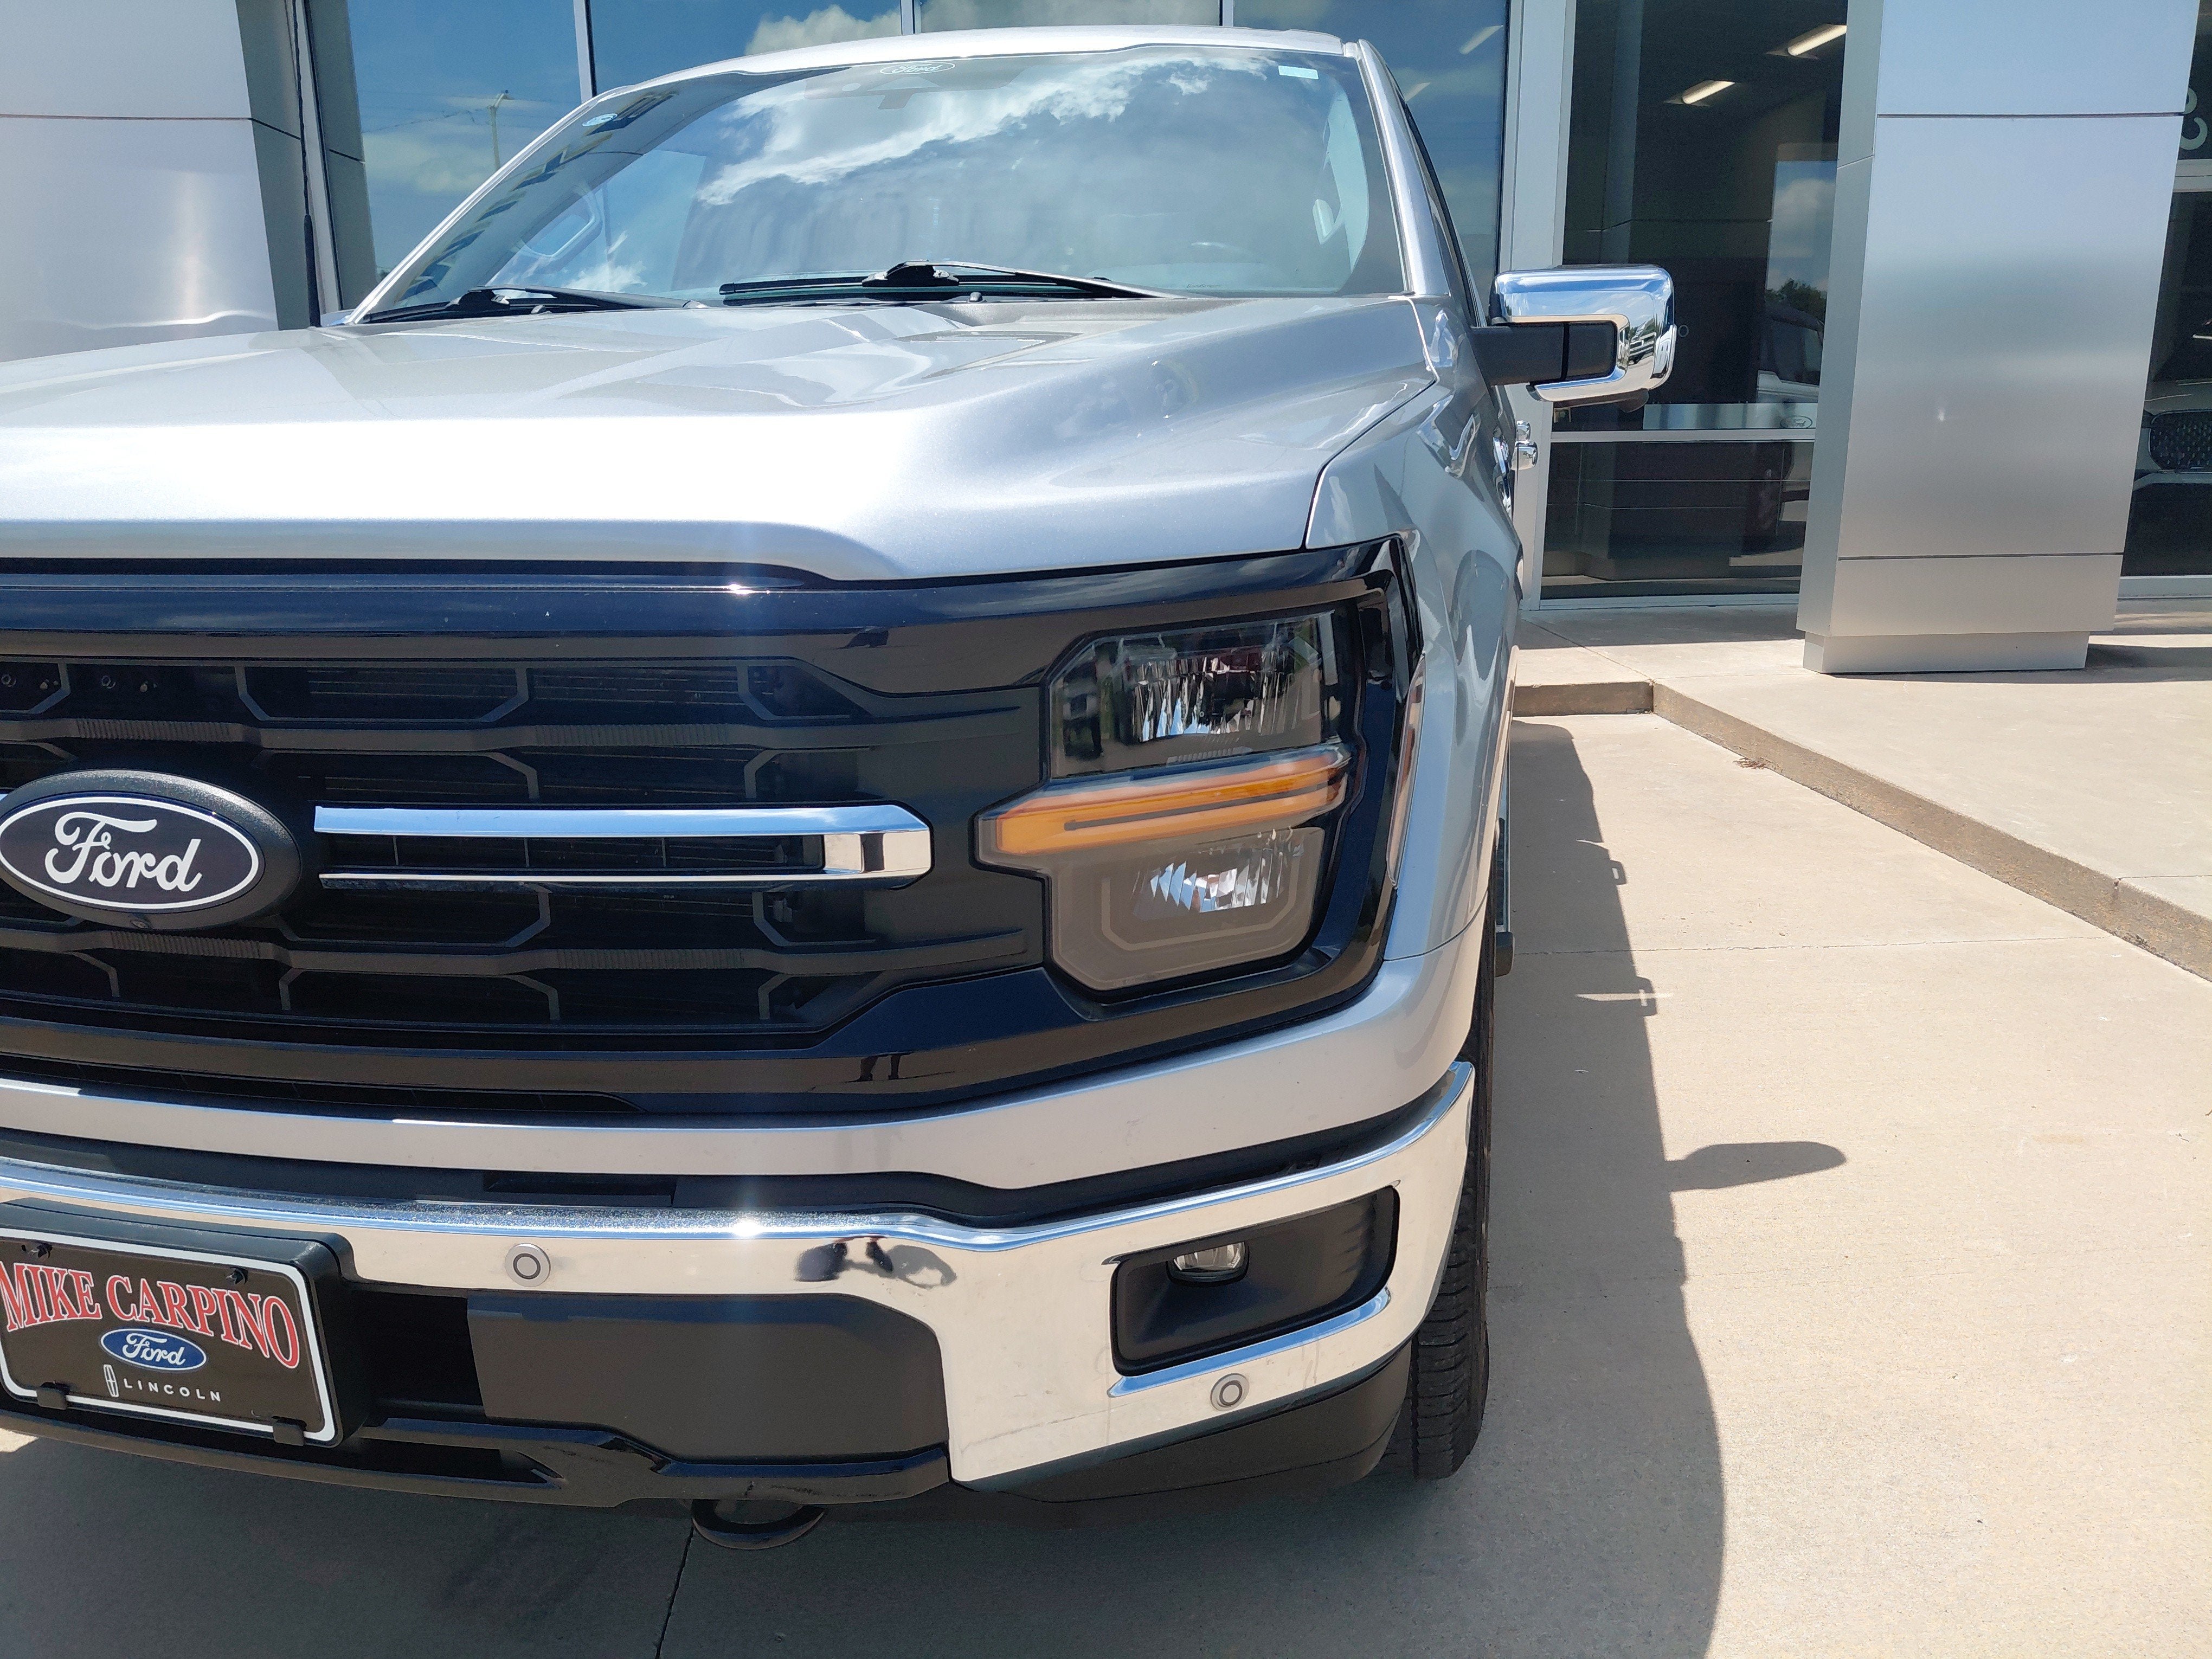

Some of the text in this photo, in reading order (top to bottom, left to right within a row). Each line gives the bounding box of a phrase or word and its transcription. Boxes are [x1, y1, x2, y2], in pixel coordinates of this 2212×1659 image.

[892, 63, 943, 73] Ford
[45, 812, 202, 892] Ford
[0, 1261, 300, 1368] MIKE CARPINO
[122, 1333, 186, 1365] Ford
[124, 1378, 221, 1402] LINCOLN
